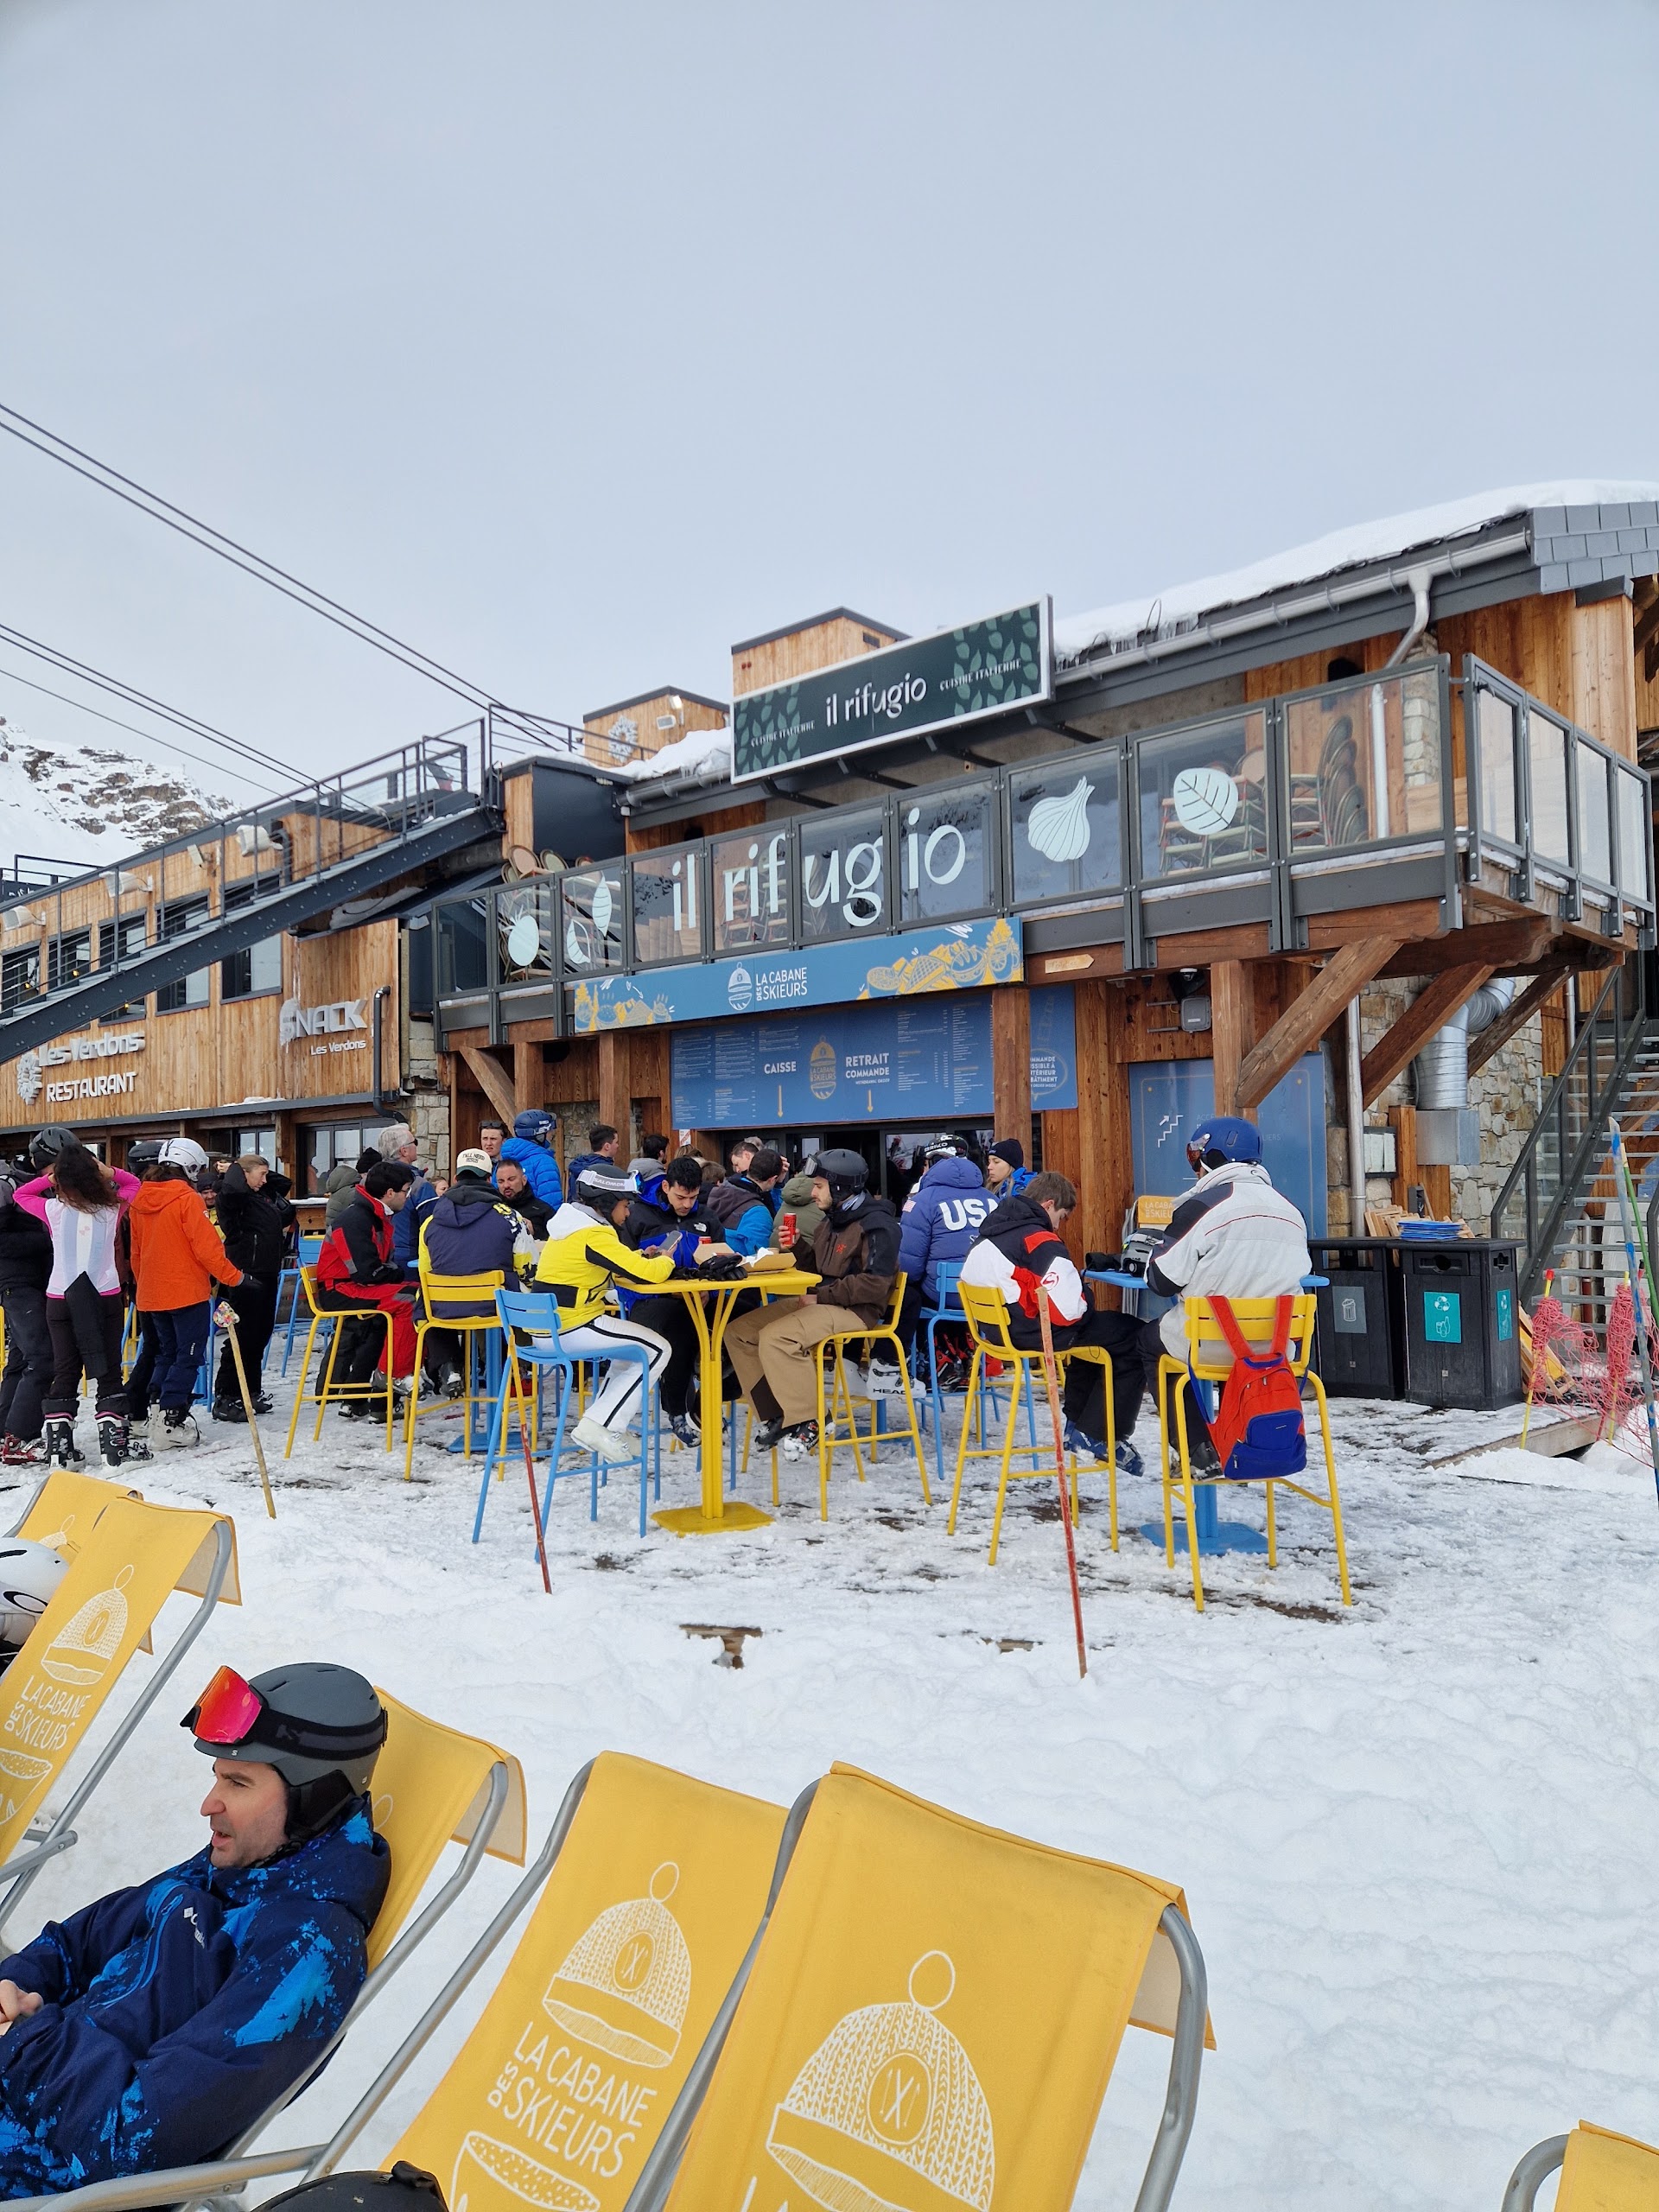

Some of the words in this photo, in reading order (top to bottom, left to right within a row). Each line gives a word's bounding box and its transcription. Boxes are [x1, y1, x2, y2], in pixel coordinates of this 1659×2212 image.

[826, 693, 838, 727] il
[845, 672, 927, 719] rifugio
[671, 853, 696, 931] il
[723, 807, 966, 927] rifugio
[756, 973, 768, 986] LA
[769, 967, 808, 984] CABANE
[763, 981, 808, 1000] SKIEURS
[39, 1042, 72, 1066] Les
[70, 1031, 145, 1061] Verdons
[311, 1045, 327, 1056] Les
[328, 1039, 366, 1052] Verdons
[846, 1052, 890, 1068] RETRAIT
[764, 1061, 797, 1075] CAISSE
[846, 1067, 890, 1079] COMMANDE
[47, 1071, 137, 1103] RESTAURANT
[21, 1675, 45, 1706] LA
[38, 1686, 92, 1719] CABANE
[3, 1700, 25, 1732] DES
[15, 1708, 76, 1751] SKIEURS
[513, 2020, 549, 2073] LA
[546, 2046, 658, 2129] CABANE
[486, 2061, 519, 2108] DES
[503, 2076, 636, 2177] SKIEURS
